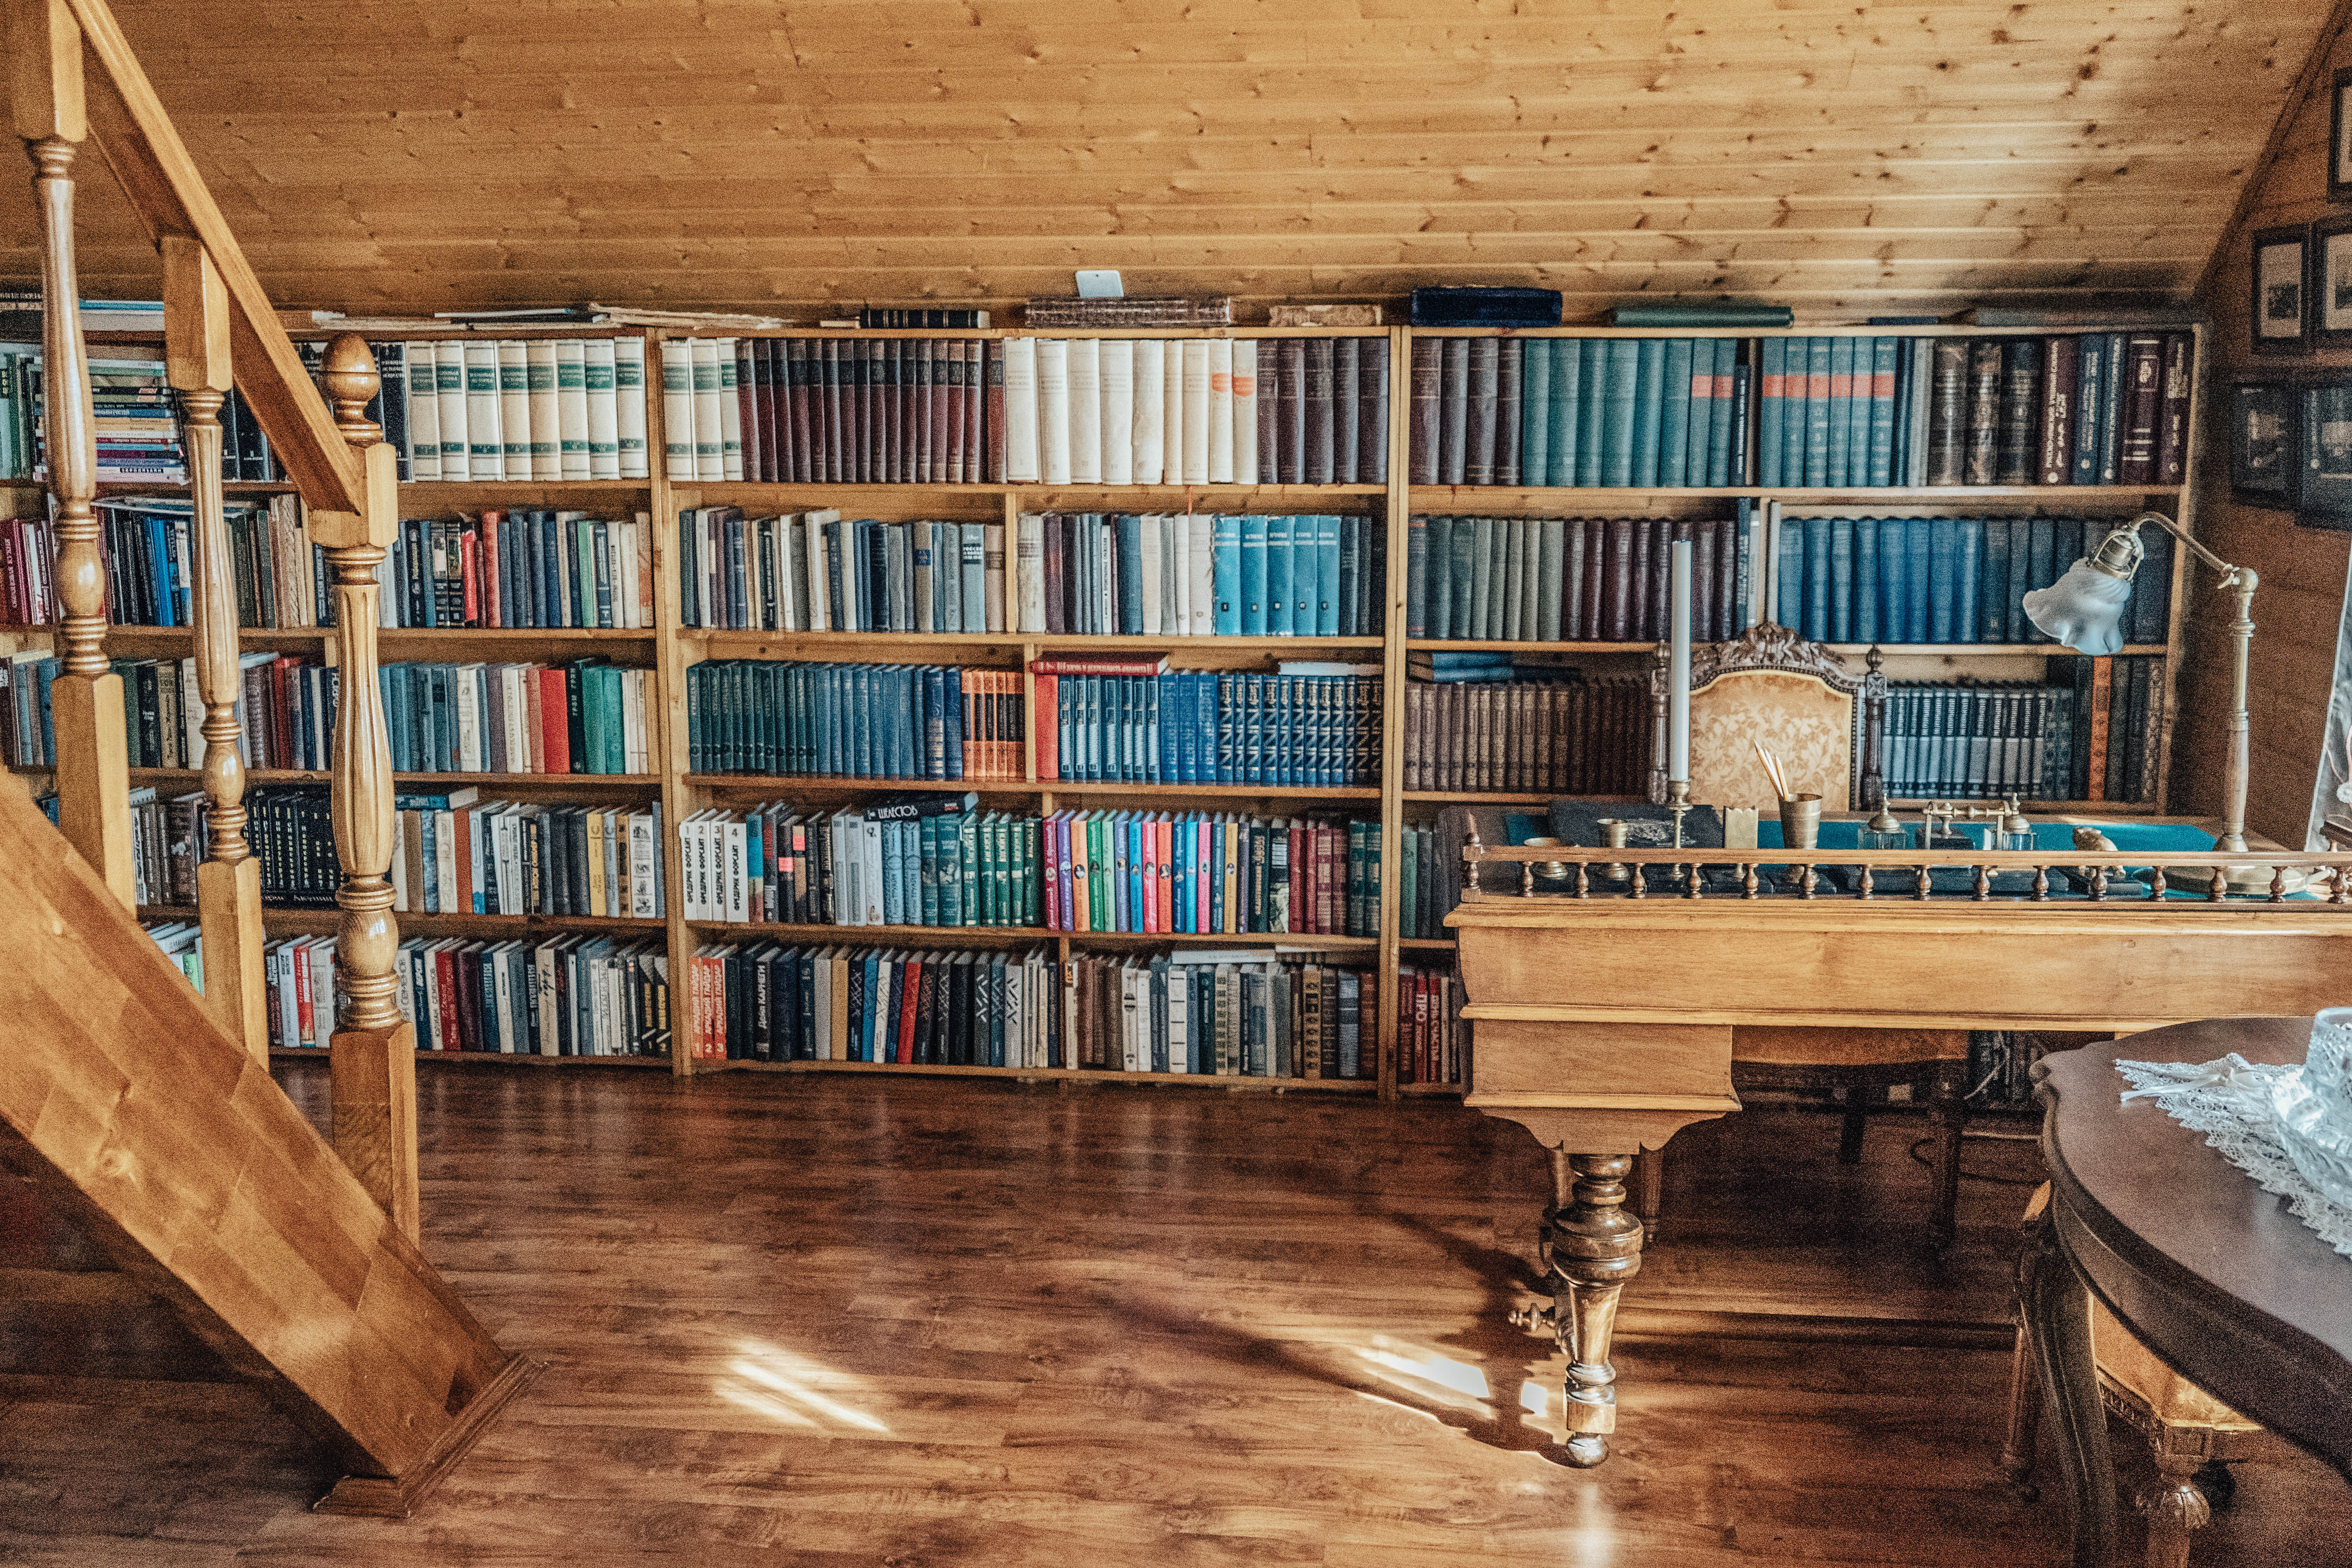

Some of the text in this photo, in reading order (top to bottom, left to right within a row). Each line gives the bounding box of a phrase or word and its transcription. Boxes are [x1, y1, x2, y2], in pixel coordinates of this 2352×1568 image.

[702, 965, 711, 995] ГАЙДАР
[758, 965, 766, 1004] КАРНЕГИ
[714, 965, 723, 1034] АРКАДИЙ ГАЙДАР
[1416, 994, 1427, 1022] ПРО
[696, 1042, 700, 1052] 1
[706, 1043, 712, 1052] 2
[717, 1043, 723, 1052] 3
[1431, 1020, 1439, 1061] СЧАСТЬЯ
